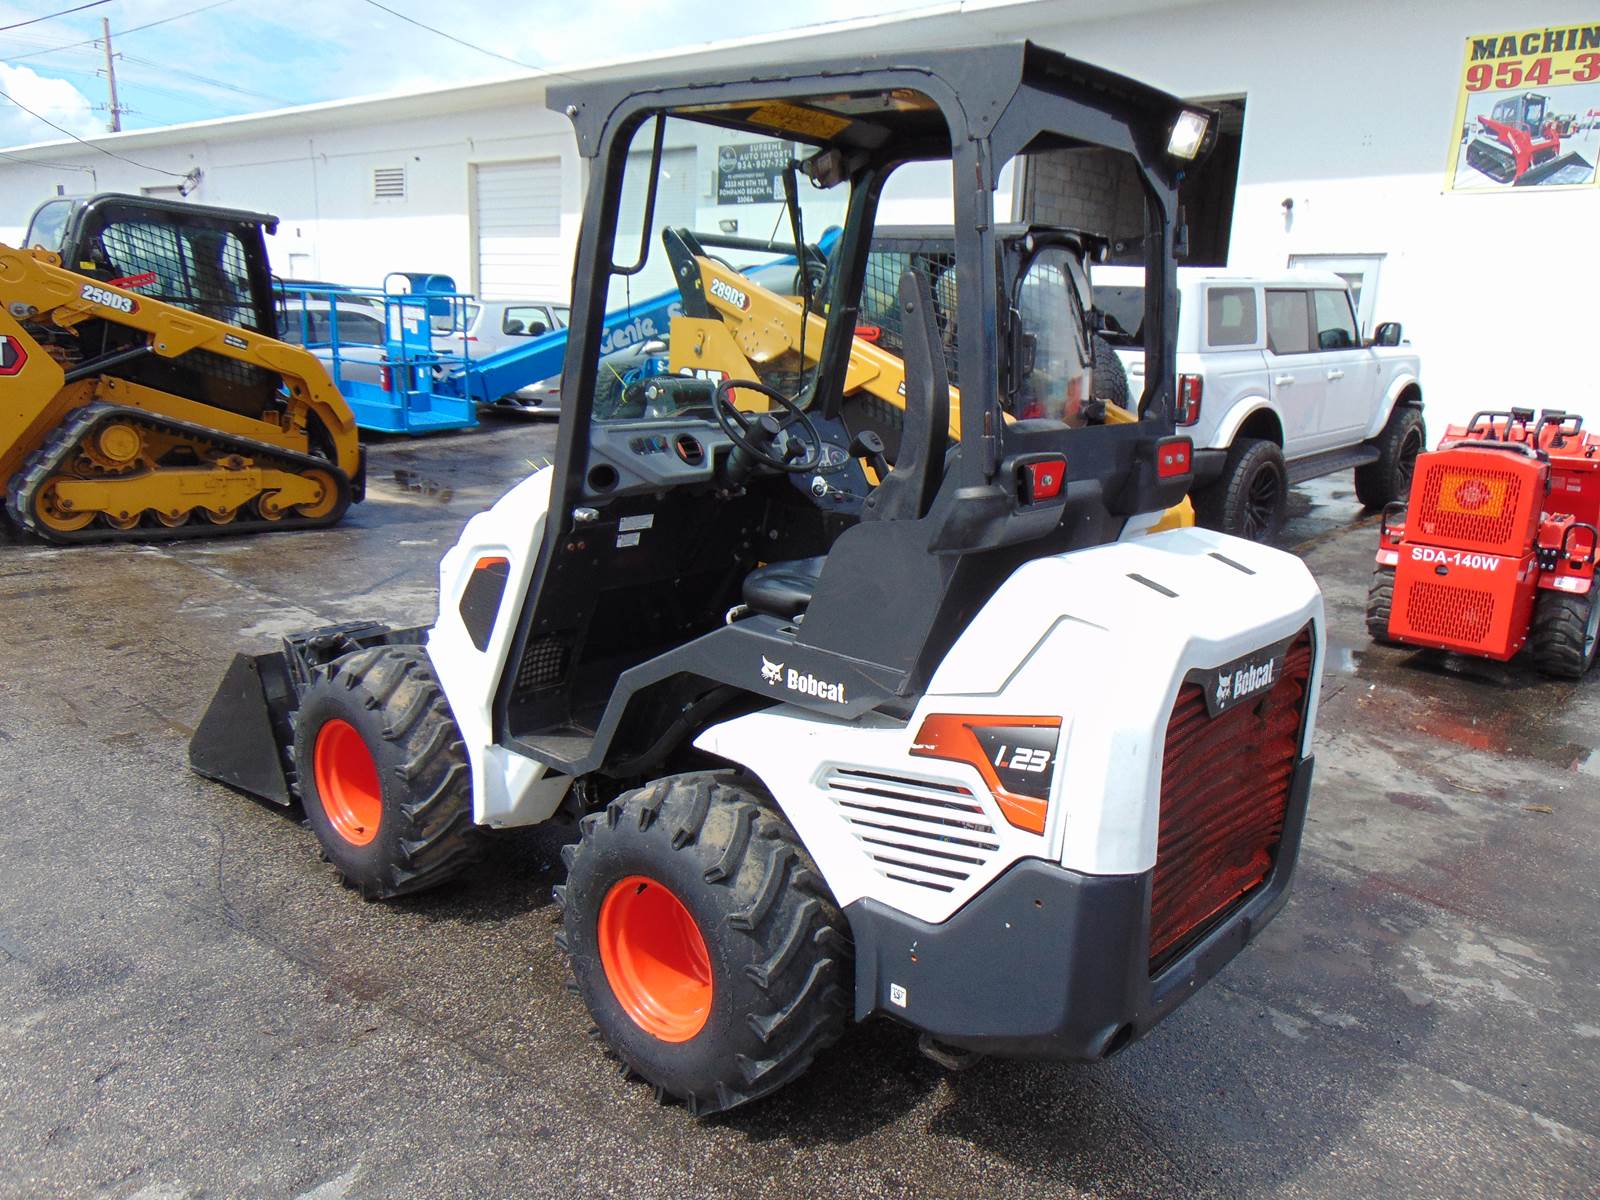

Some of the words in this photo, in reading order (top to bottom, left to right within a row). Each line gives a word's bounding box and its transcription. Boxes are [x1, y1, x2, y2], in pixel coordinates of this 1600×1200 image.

[1465, 53, 1600, 91] 954-3
[81, 284, 133, 314] 259D3
[711, 278, 746, 308] 289D3
[1411, 547, 1499, 571] SDA-140W
[787, 668, 846, 704] Bobcat
[1233, 658, 1275, 699] Bobcat
